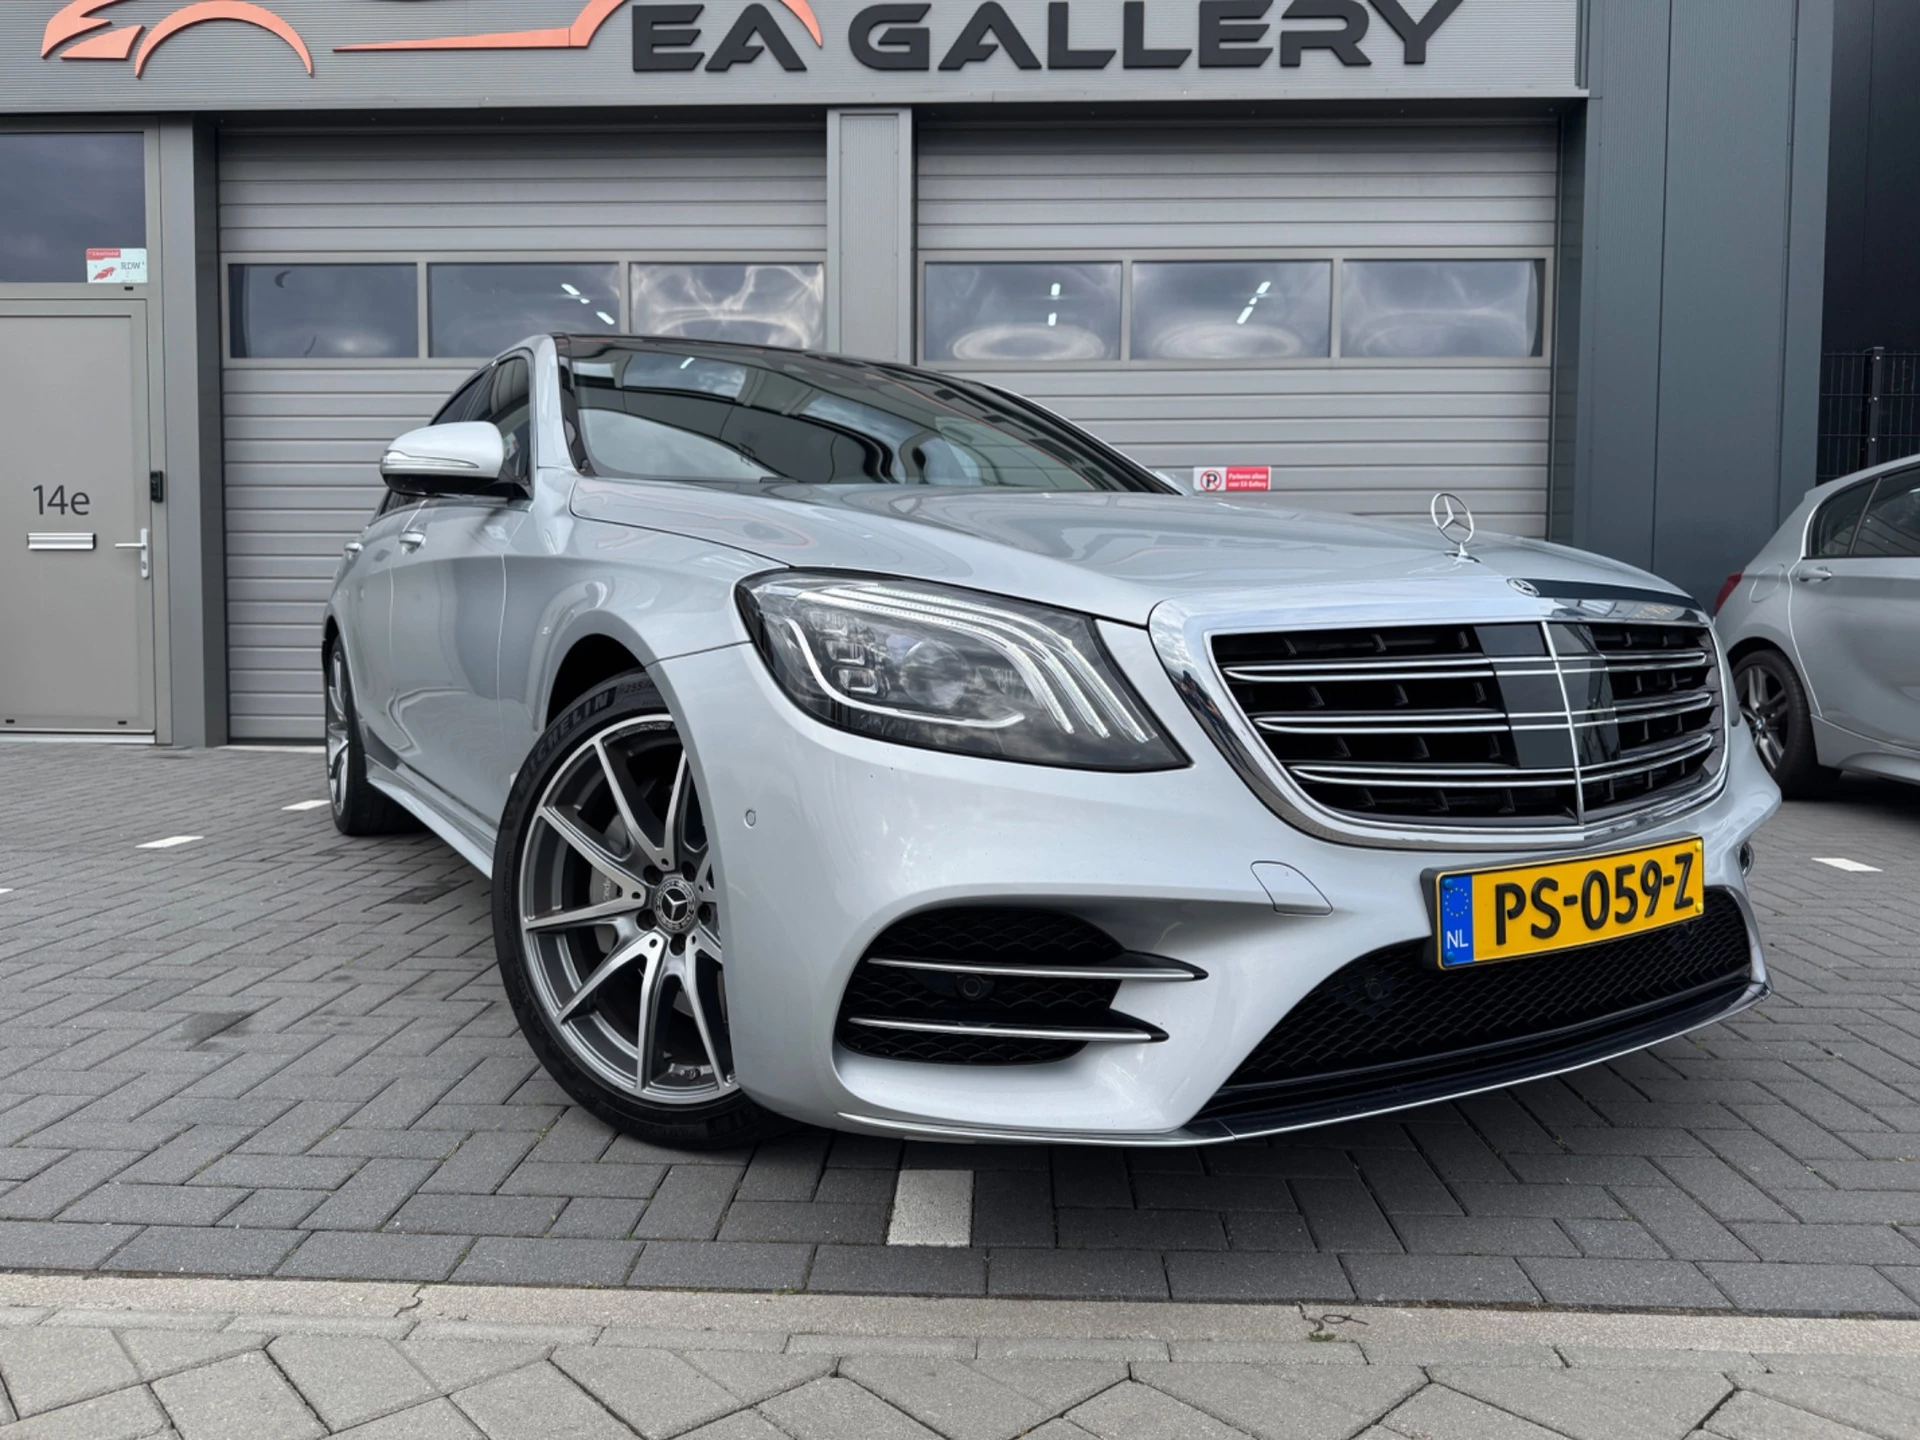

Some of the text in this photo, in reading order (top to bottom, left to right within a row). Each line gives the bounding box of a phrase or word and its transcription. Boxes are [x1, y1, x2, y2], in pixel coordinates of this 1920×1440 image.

[632, 0, 1463, 72] EA GALLERY
[33, 484, 90, 516] 14e
[517, 690, 611, 795] MICHELIN
[1495, 853, 1694, 946] PS-059-Z
[1446, 929, 1469, 949] NL
